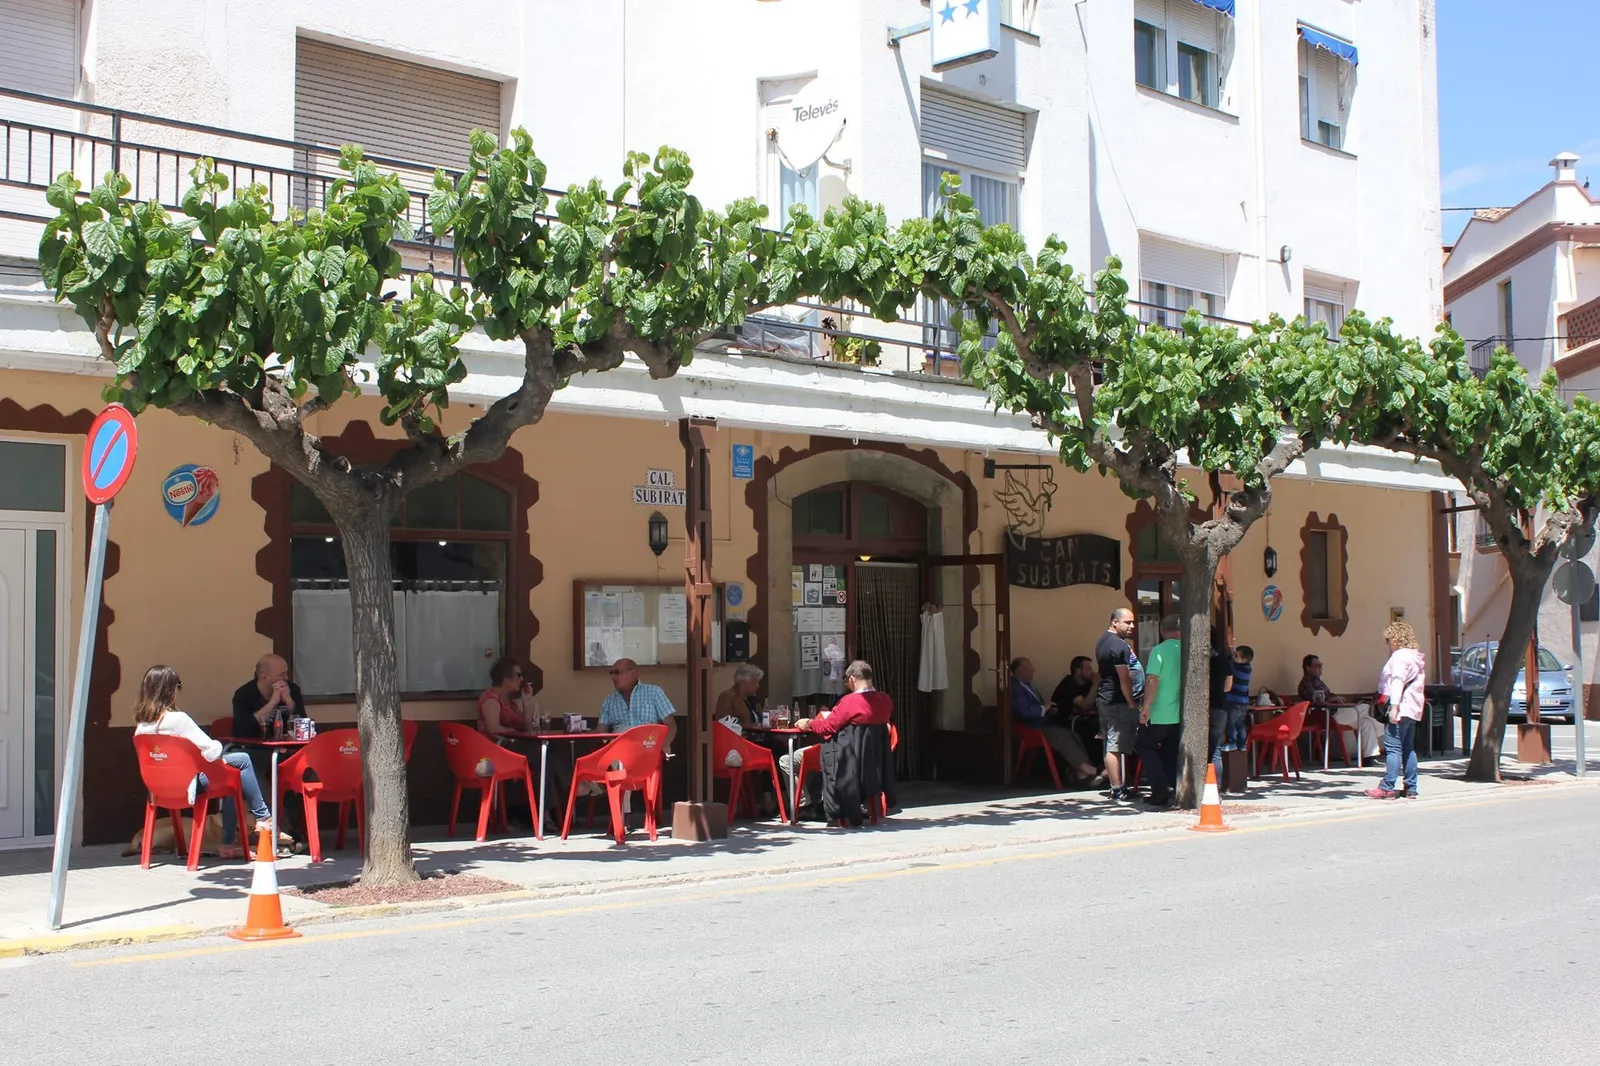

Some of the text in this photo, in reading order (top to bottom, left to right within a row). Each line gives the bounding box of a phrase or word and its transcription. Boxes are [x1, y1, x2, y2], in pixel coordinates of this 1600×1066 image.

[792, 98, 839, 122] Televés
[650, 471, 671, 486] CAL
[169, 483, 194, 499] Nestlé
[1017, 560, 1111, 587] SUBIRATS
